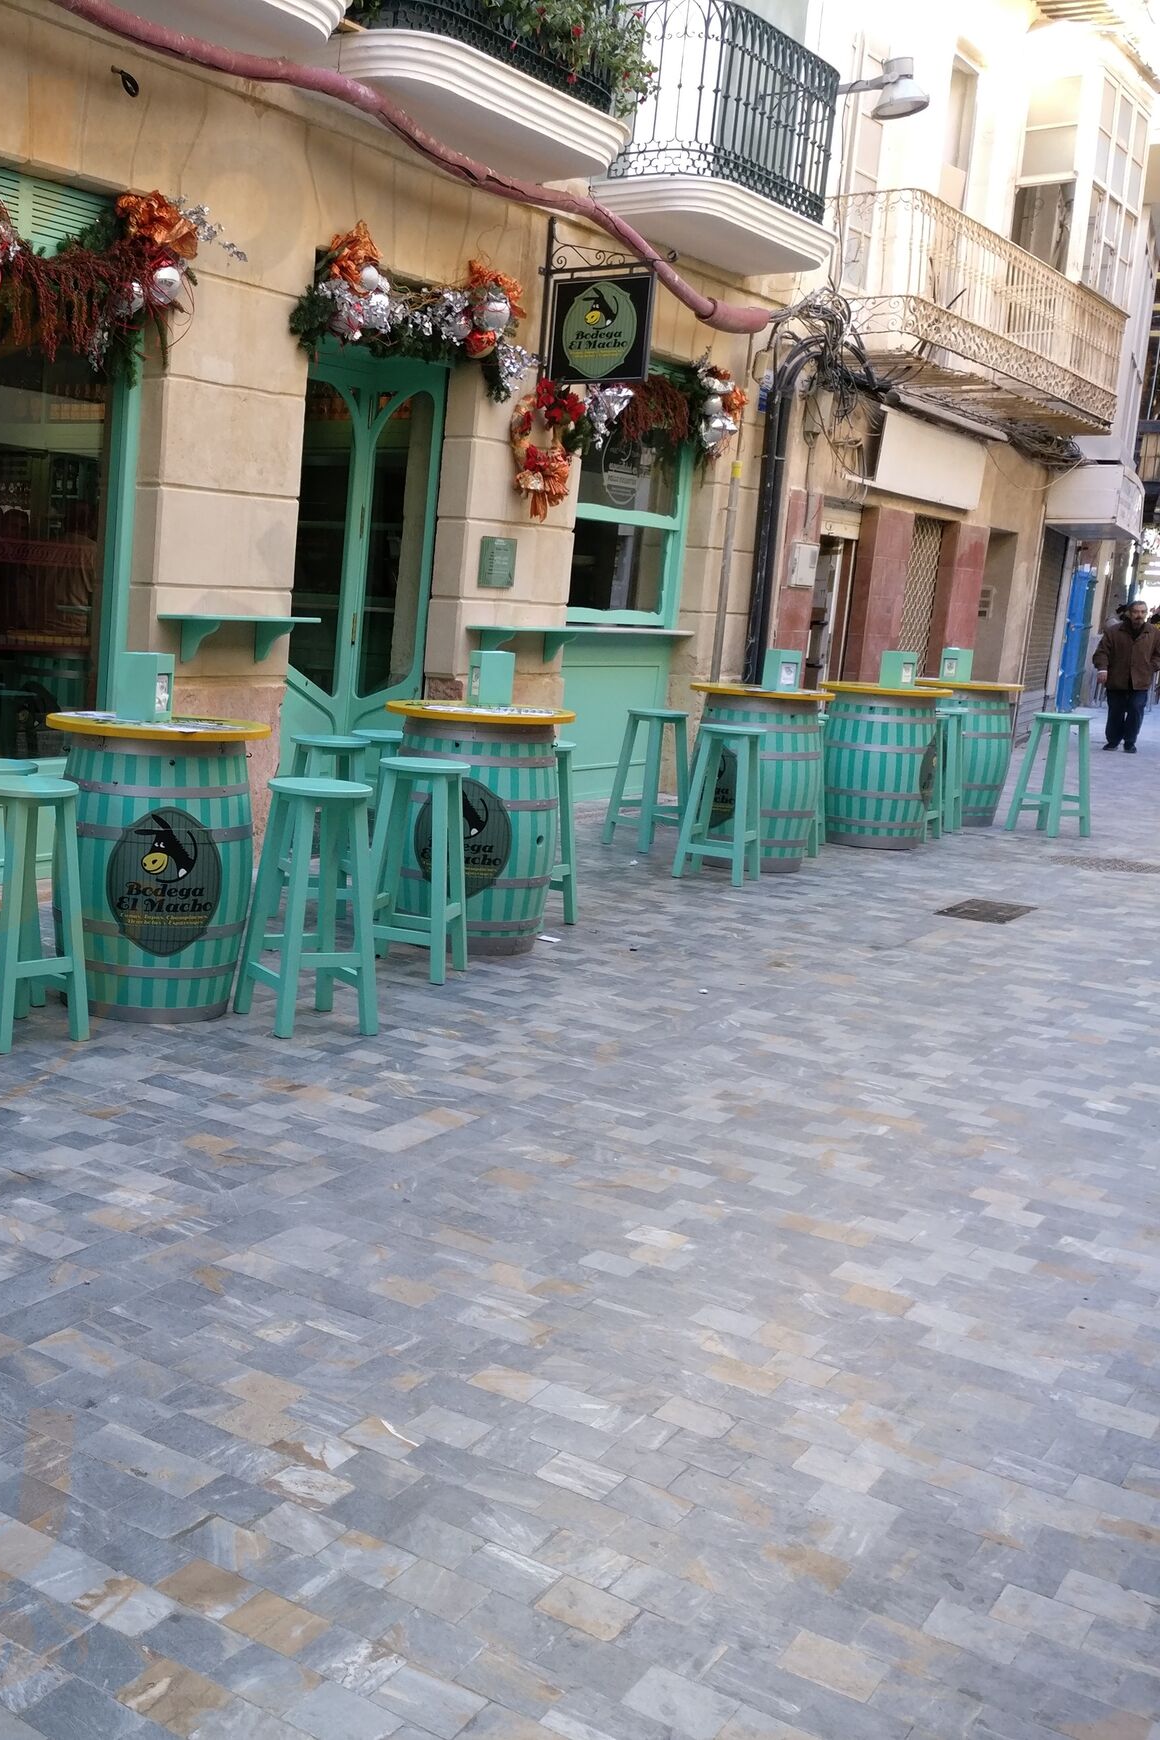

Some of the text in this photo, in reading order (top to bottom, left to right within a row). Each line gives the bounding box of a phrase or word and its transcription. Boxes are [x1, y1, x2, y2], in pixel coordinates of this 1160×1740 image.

[575, 330, 623, 340] Bodega
[568, 338, 628, 350] El Macho
[126, 882, 205, 899] Bodega
[116, 896, 213, 912] El Macho
